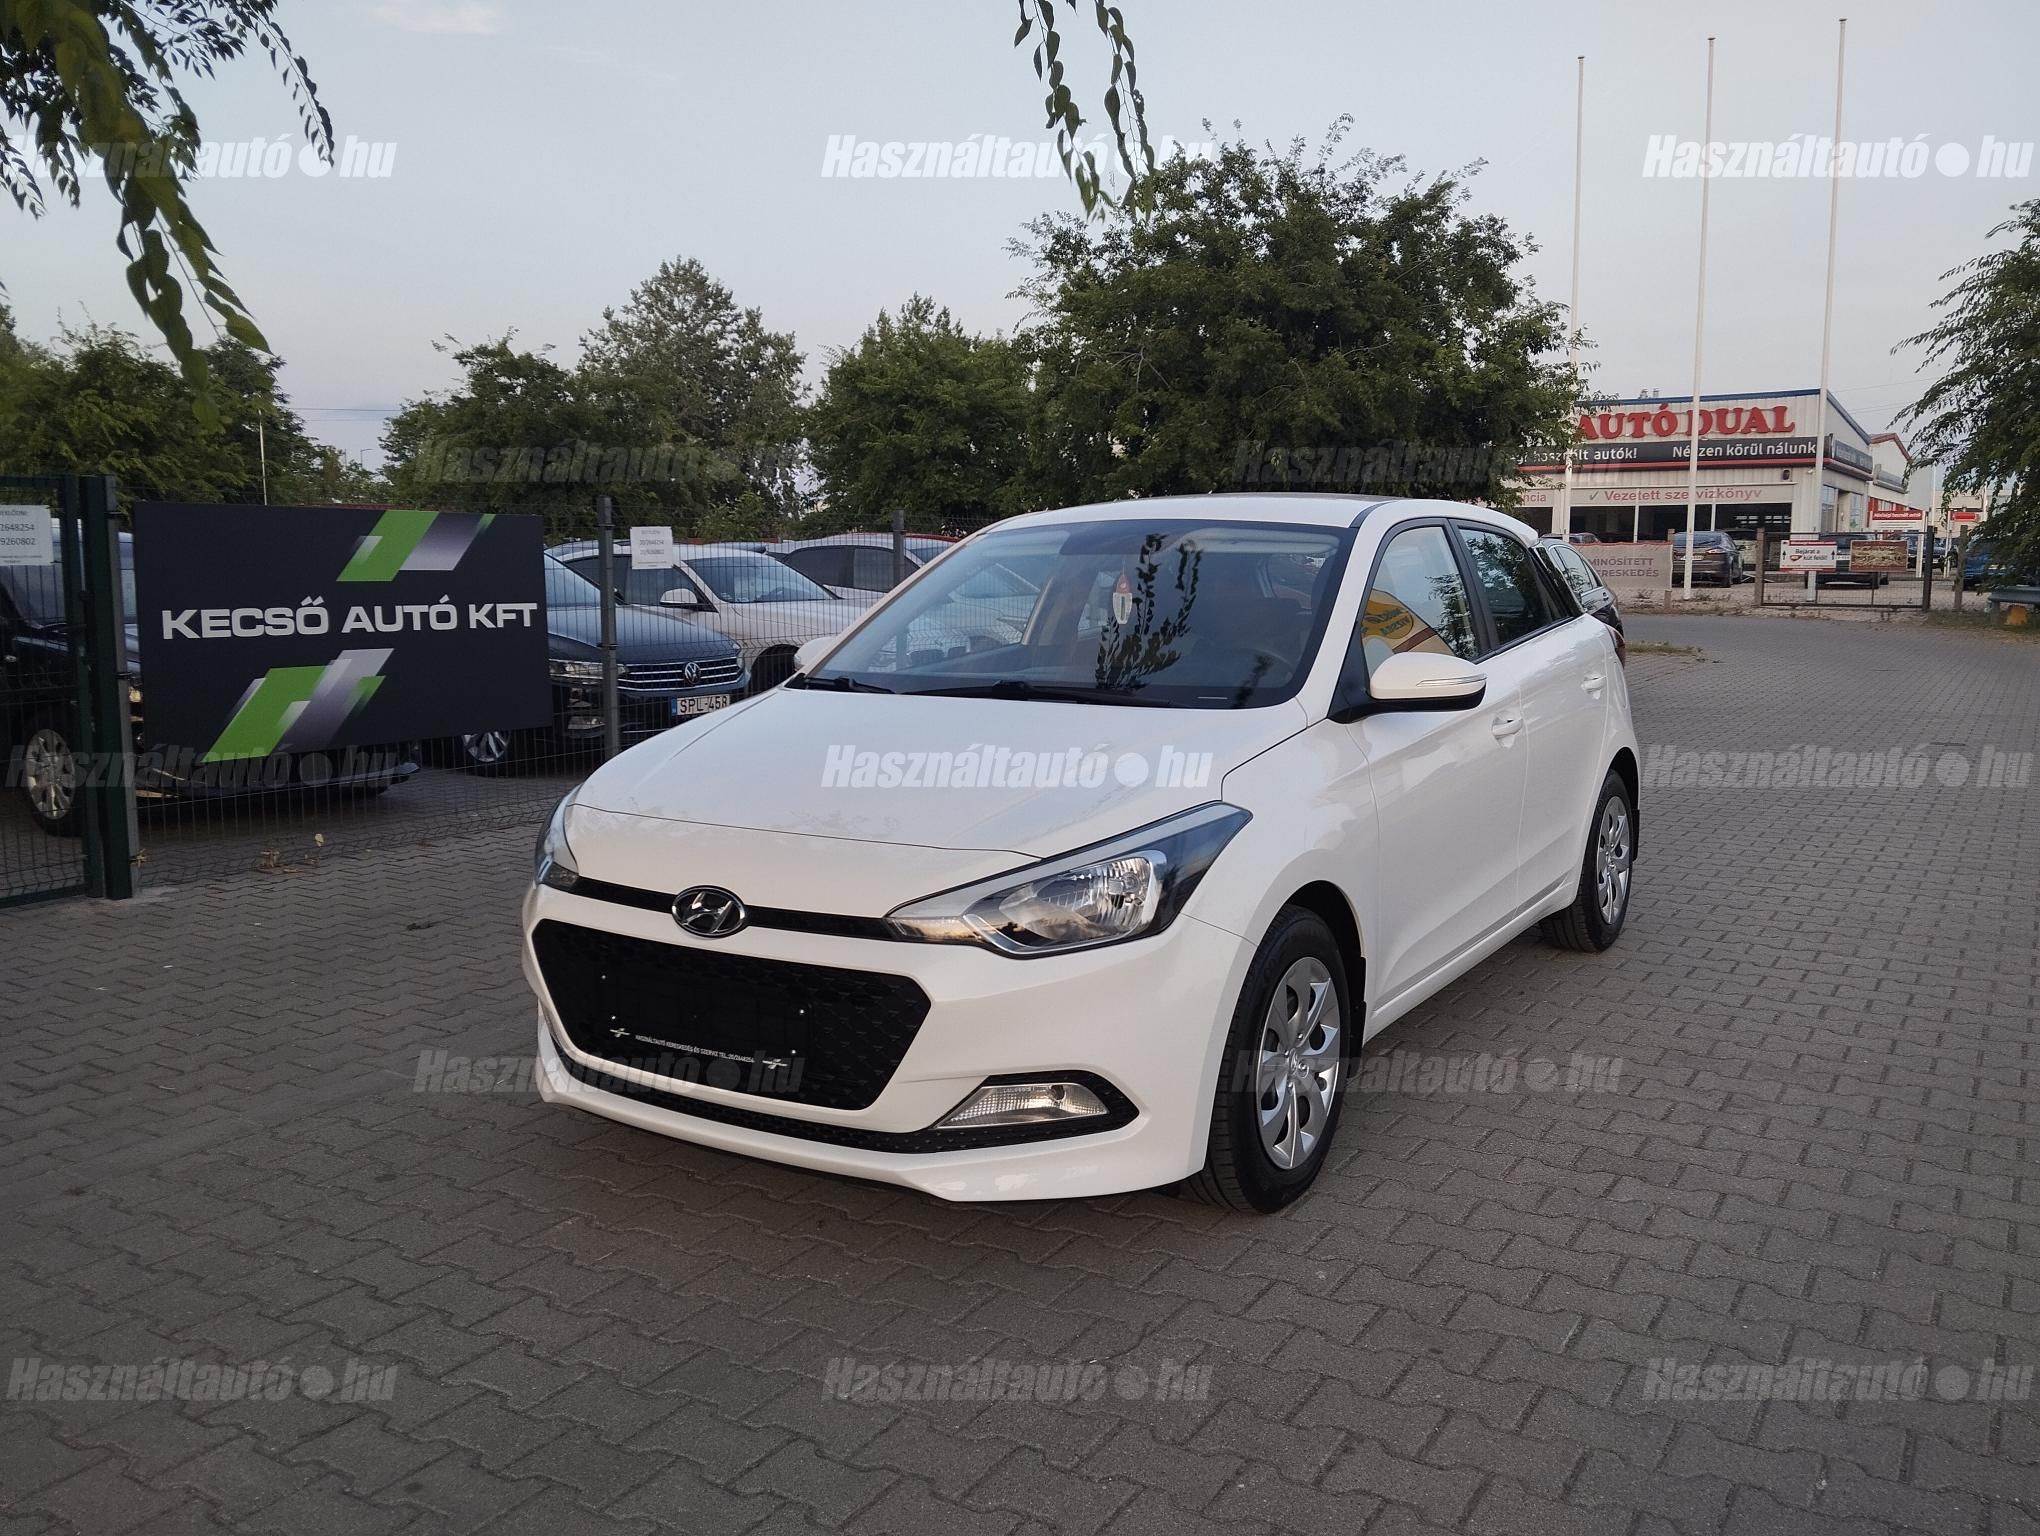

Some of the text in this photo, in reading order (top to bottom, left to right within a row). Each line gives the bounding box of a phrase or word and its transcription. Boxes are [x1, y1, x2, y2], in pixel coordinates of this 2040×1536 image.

[1579, 402, 1796, 440] AUTÓ DUAL
[1594, 447, 1638, 460] autók!
[1672, 445, 1723, 458] Nézen
[1726, 442, 1763, 456] körül
[1766, 441, 1816, 455] nálunk
[1604, 489, 1661, 501] Vezetett
[1665, 488, 1762, 501] szevizkönyv
[1597, 567, 1659, 577] ERESKEDÉS
[161, 593, 538, 640] KECSŐ AUTÓ KFT
